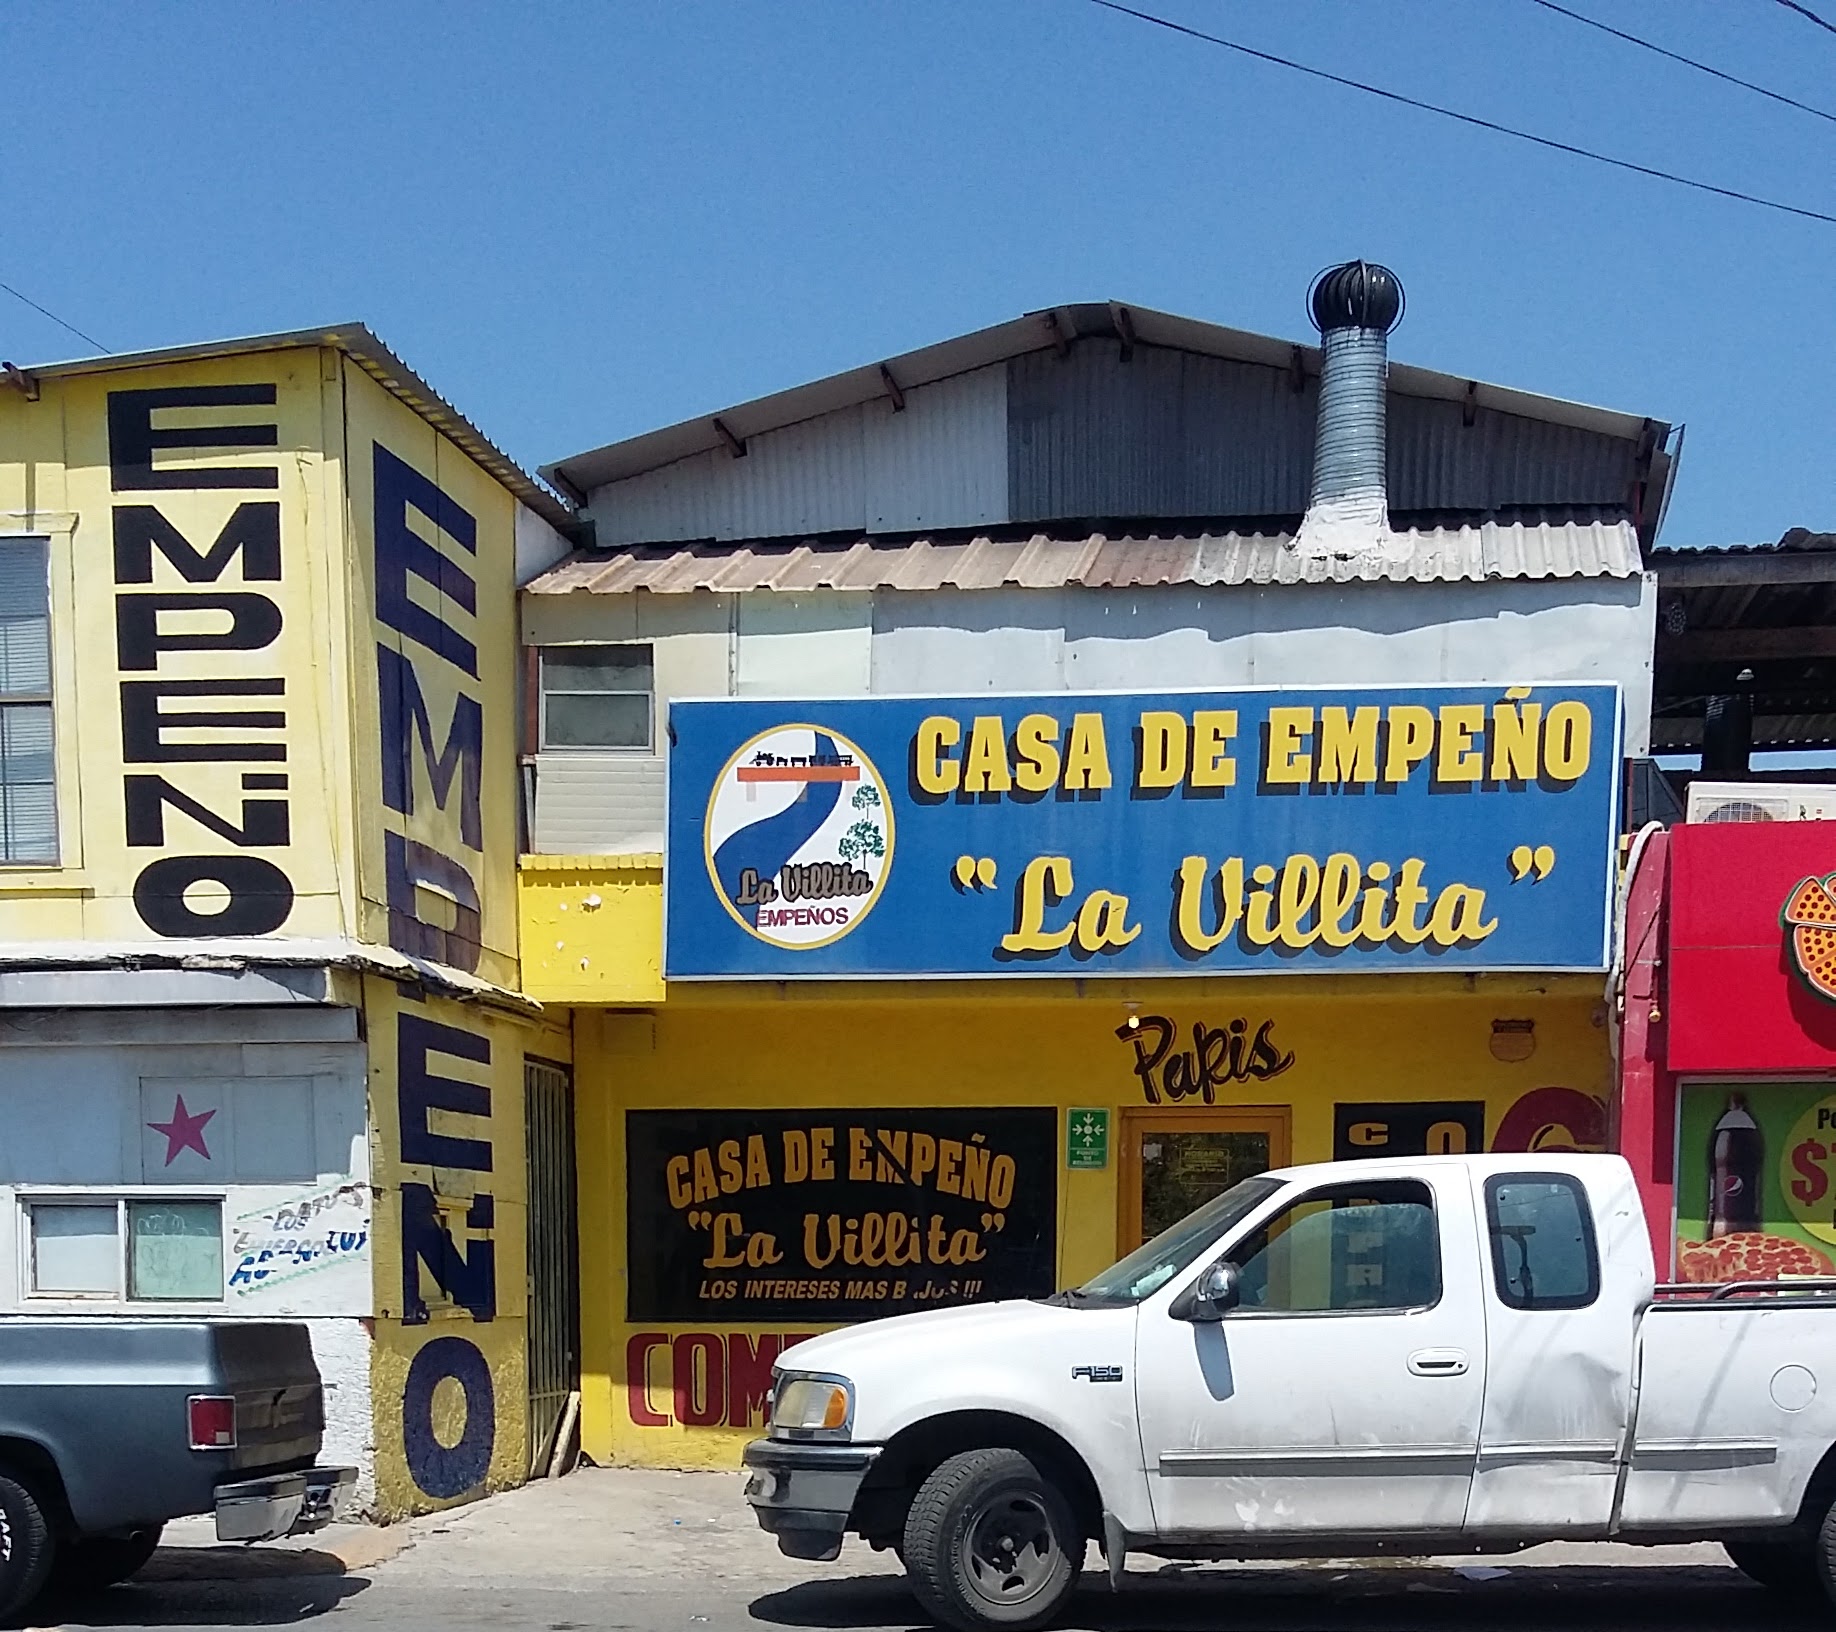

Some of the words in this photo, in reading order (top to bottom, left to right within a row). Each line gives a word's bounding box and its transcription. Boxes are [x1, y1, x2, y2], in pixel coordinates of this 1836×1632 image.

[107, 383, 294, 938] EMPEÑO
[909, 712, 1112, 806] CASA
[1131, 709, 1238, 801] DE
[1256, 686, 1592, 796] EMPEÑO
[735, 868, 779, 905] La
[781, 861, 874, 903] Villita
[757, 905, 849, 928] EMPEÑOS
[1114, 1016, 1296, 1104] Papis
[666, 1134, 771, 1210] CASA
[782, 1127, 835, 1184] DE
[849, 1127, 1016, 1209] EMPEÑO
[699, 1280, 738, 1299] LOS
[744, 1280, 840, 1299] INTERESES
[844, 1280, 888, 1299] MAS
[627, 1332, 822, 1427] COM
